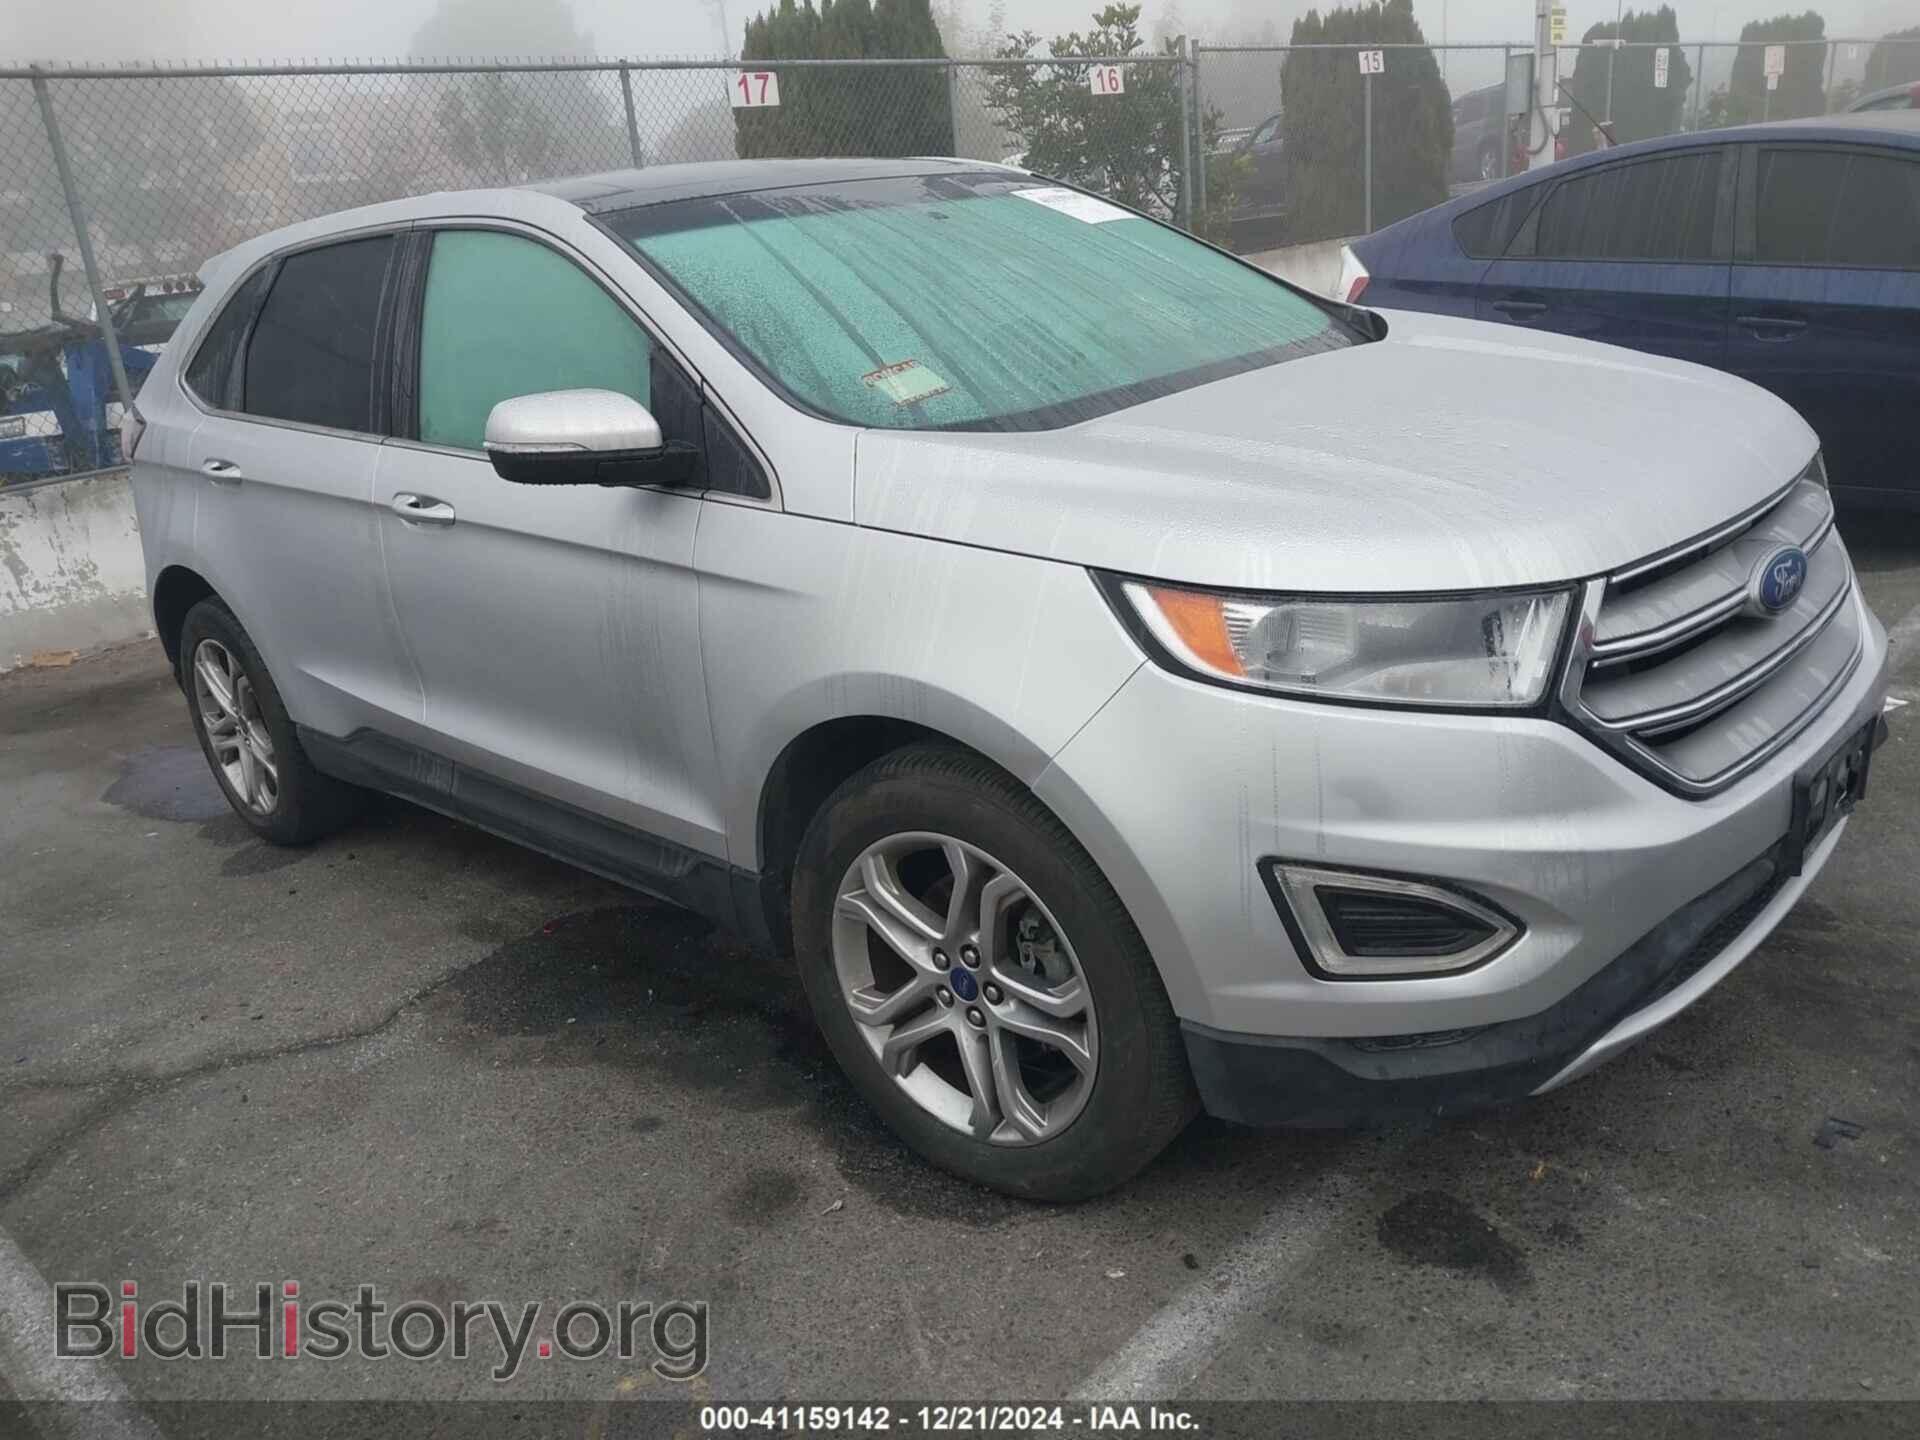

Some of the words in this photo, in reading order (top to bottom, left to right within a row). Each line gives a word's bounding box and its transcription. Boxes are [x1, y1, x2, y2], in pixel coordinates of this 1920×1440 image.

[1363, 51, 1381, 72] 15
[738, 74, 769, 105] 17
[1096, 68, 1120, 92] 16
